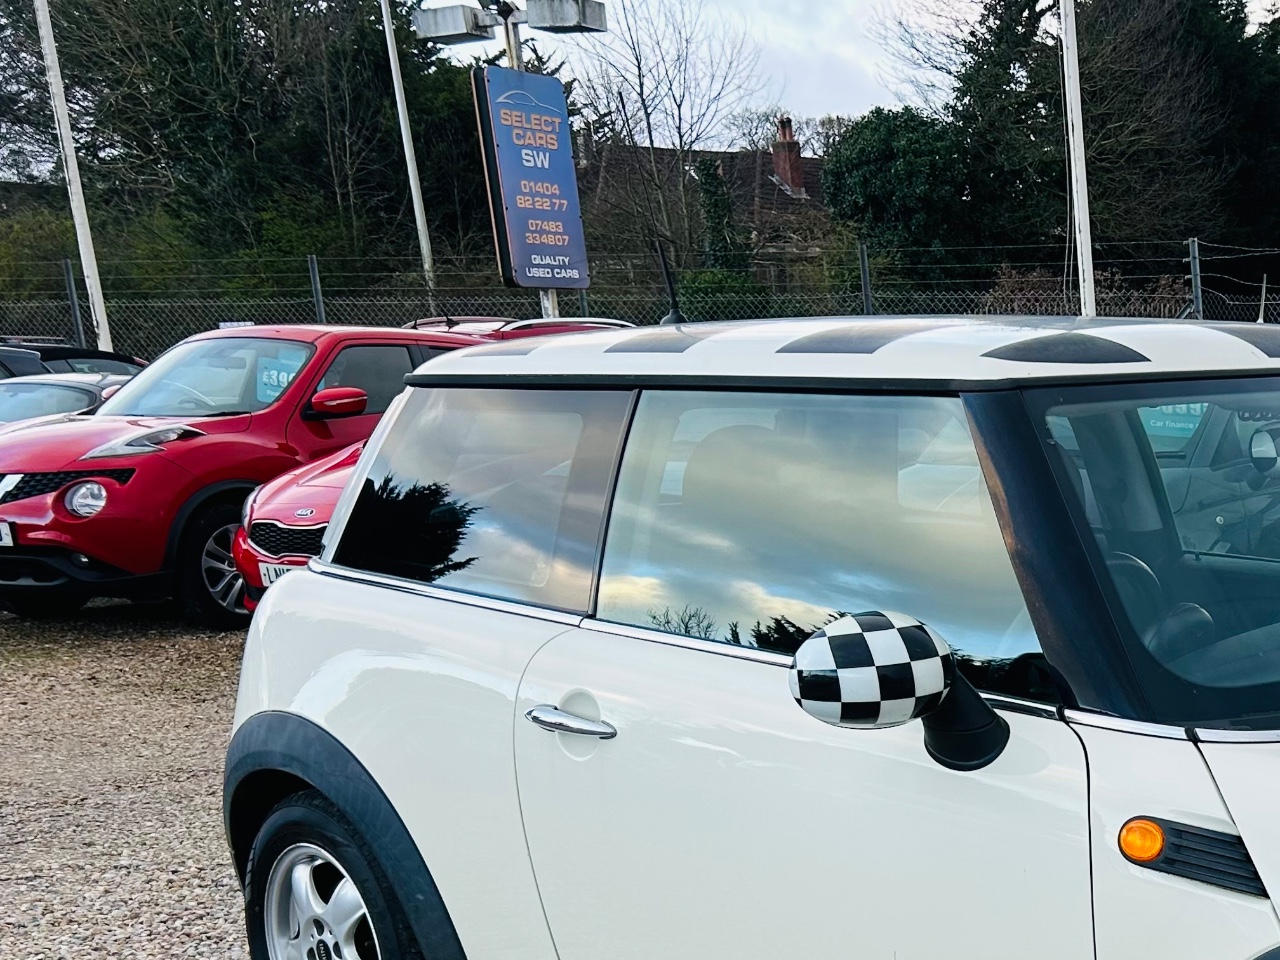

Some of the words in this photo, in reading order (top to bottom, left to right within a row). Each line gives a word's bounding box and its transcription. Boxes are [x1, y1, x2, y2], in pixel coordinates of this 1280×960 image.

[501, 109, 562, 133] SELECT
[513, 129, 559, 150] CARS
[521, 149, 550, 169] SW
[521, 180, 560, 195] 01404
[517, 195, 533, 208] 82
[535, 197, 551, 210] 22
[553, 199, 568, 211] 77
[529, 220, 563, 232] 07483
[526, 233, 569, 246] 334807
[531, 254, 570, 266] QUALITY
[526, 267, 553, 278] USED
[554, 268, 579, 279] CARS
[1150, 419, 1164, 427] Car
[1165, 420, 1194, 429] finance
